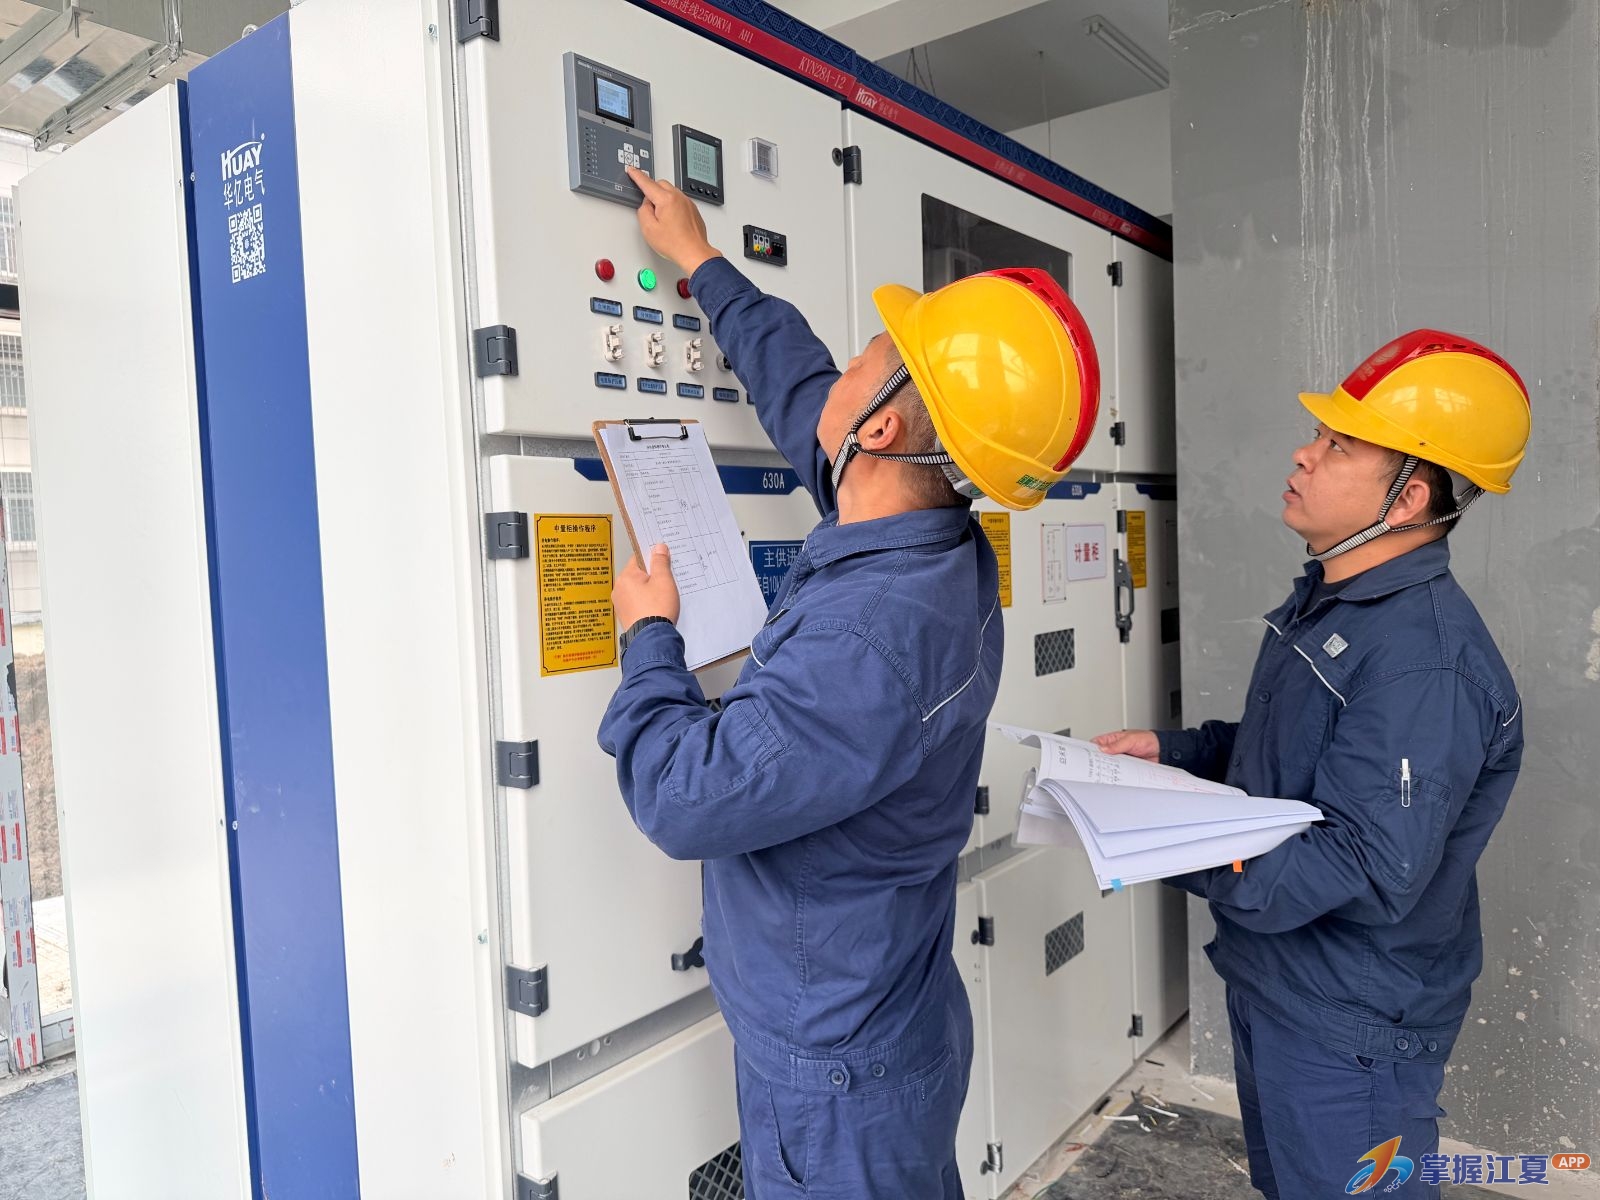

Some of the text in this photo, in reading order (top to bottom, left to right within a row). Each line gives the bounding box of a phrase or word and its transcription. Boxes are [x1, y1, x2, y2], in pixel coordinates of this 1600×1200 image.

[661, 0, 732, 34] 源进线2500KVA
[798, 56, 847, 90] KYN28A-12
[855, 87, 878, 109] HUAY
[220, 141, 263, 182] HUAY
[223, 168, 266, 211] 华亿电气
[762, 472, 785, 489] 630A
[763, 547, 802, 568] 主供进
[1073, 542, 1100, 564] 计量柜
